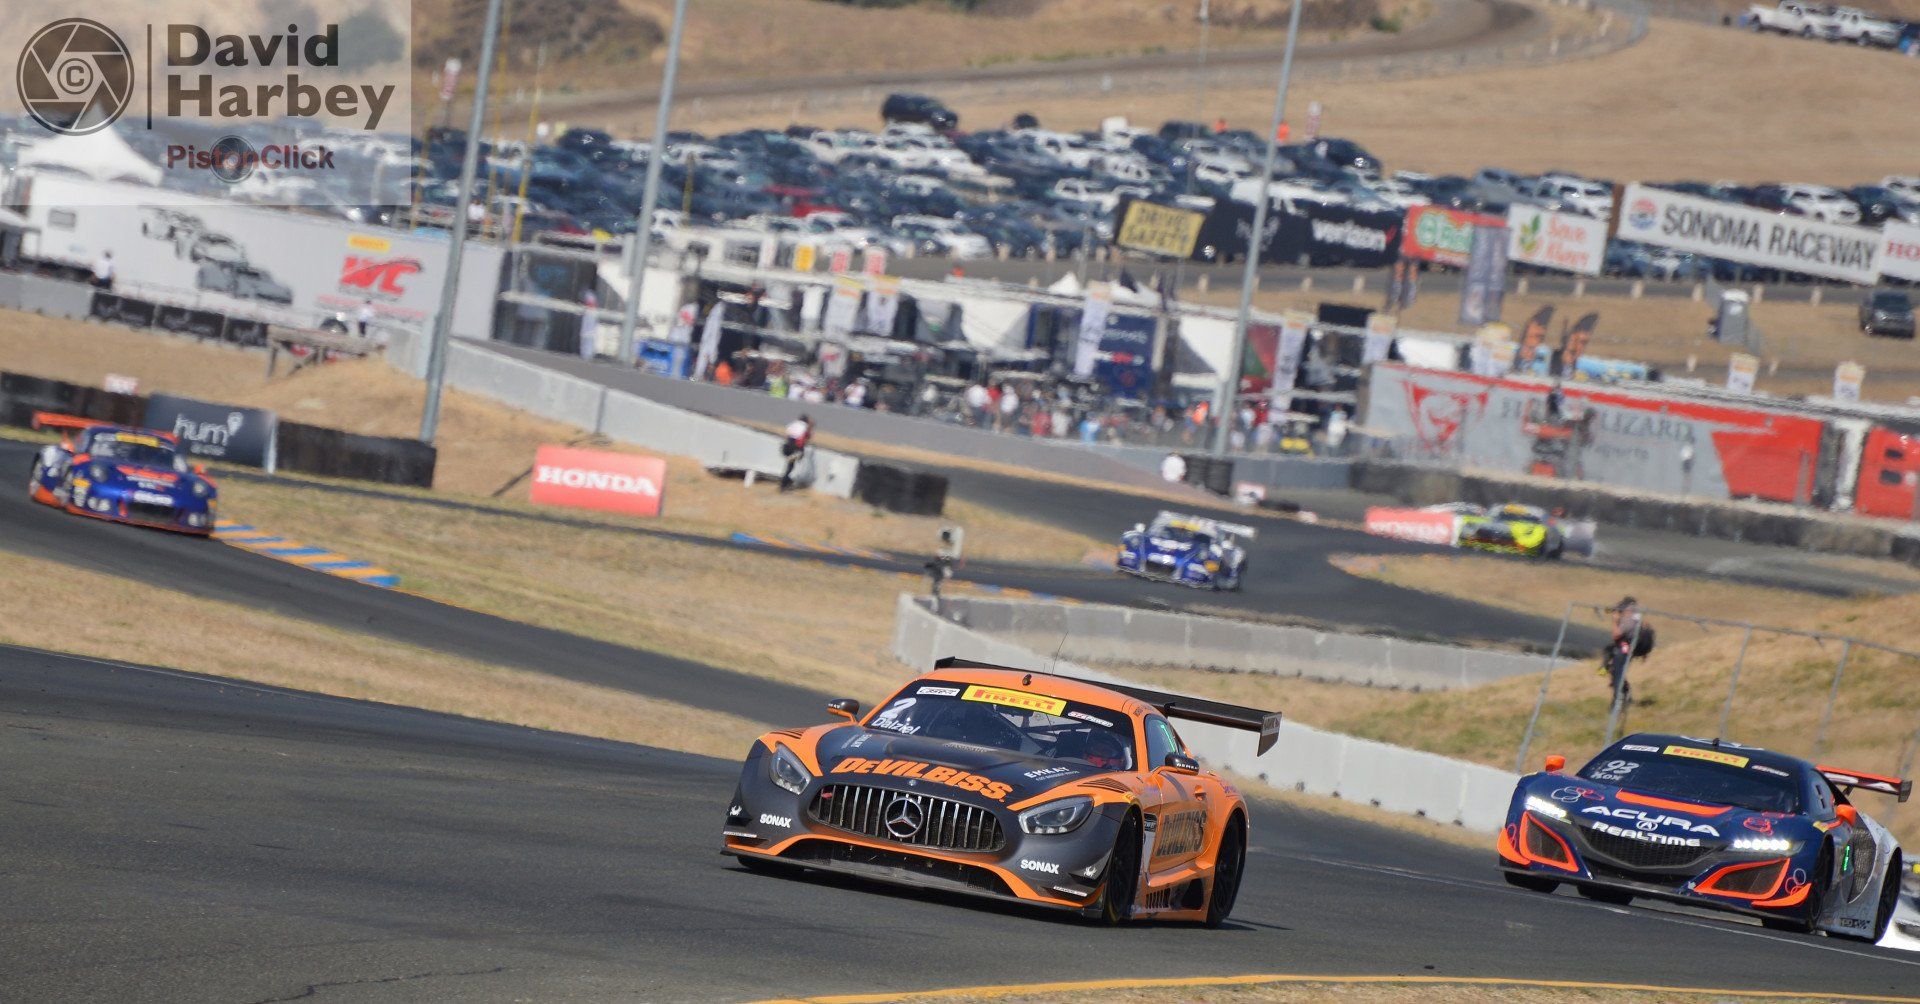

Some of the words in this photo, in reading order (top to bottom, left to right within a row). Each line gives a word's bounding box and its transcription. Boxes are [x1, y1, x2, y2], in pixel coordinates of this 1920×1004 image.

[1661, 203, 1761, 252] SONOMA
[1768, 223, 1877, 270] RACEWAY
[536, 464, 660, 497] HONDA
[878, 697, 917, 720] 2
[871, 716, 922, 735] Dalziel
[1023, 766, 1070, 779] EMKAY
[1602, 759, 1640, 774] 93
[759, 813, 791, 829] SONAX
[1581, 805, 1720, 838] ACURA
[1591, 820, 1701, 847] REALTIME
[1020, 858, 1060, 875] SONAX
